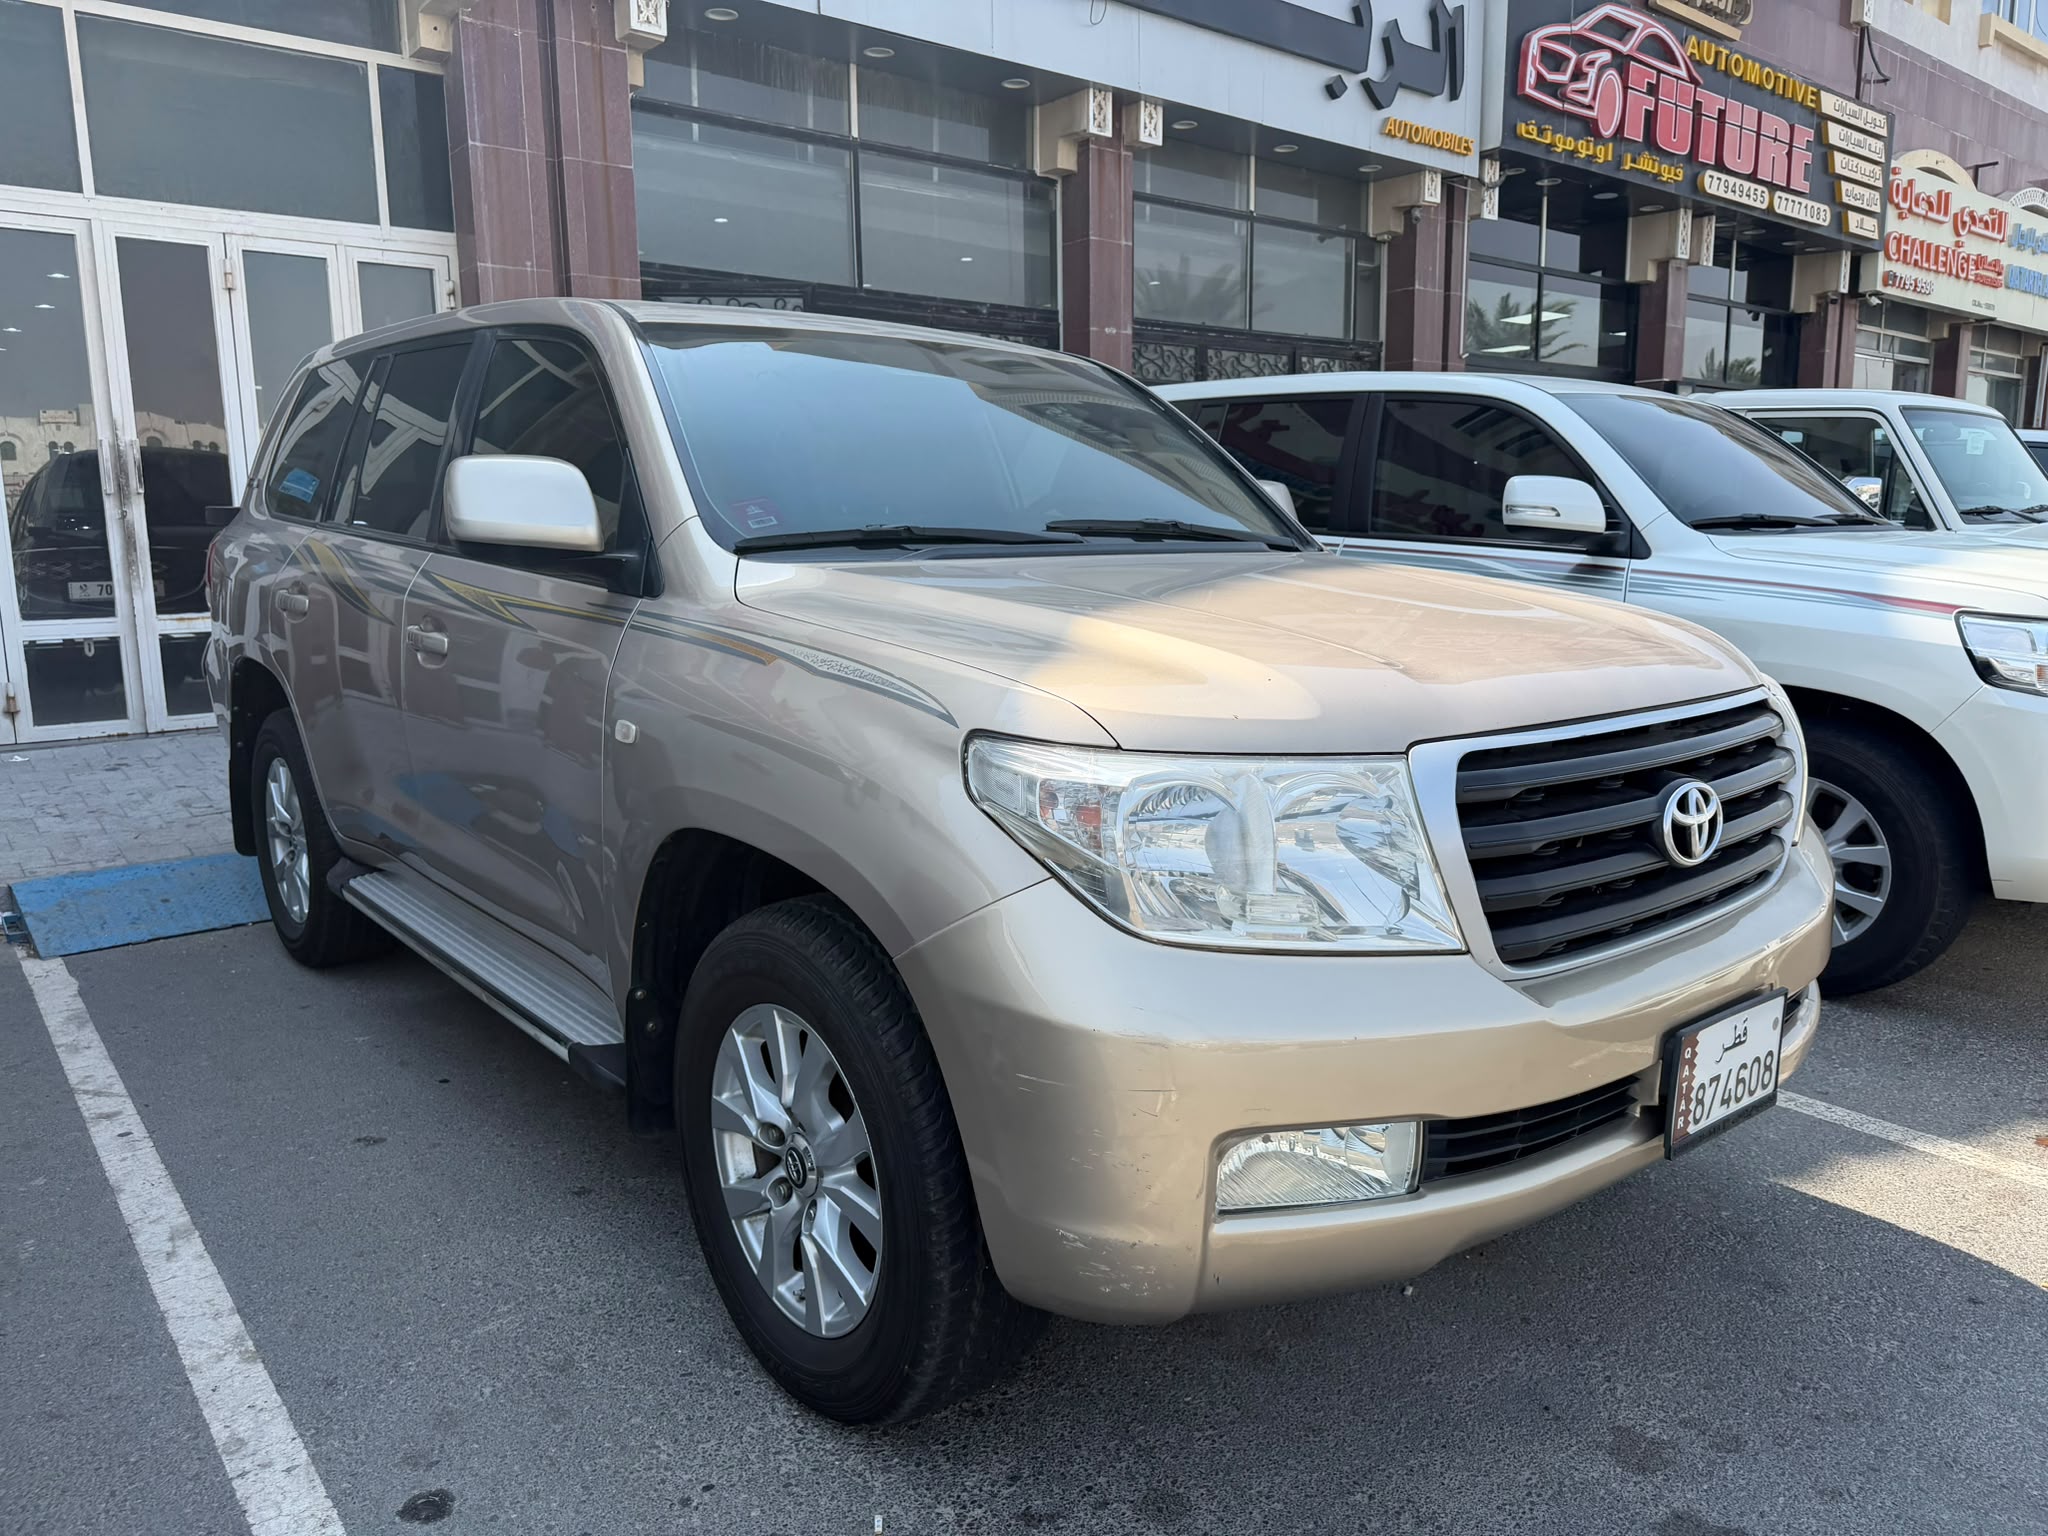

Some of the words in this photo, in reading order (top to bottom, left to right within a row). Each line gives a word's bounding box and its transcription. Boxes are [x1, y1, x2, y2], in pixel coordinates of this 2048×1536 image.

[1686, 35, 1818, 108] AUTOMOTIVE
[1622, 60, 1815, 194] FUTURE
[1834, 98, 1863, 121] السيارات
[1382, 116, 1475, 157] AUTOMOBILES
[1839, 129, 1867, 152] السيارات
[1620, 151, 1685, 183] فيوتشر
[1708, 174, 1766, 205] 77949455
[1777, 195, 1828, 223] 77771083
[1884, 231, 1977, 281] CHALLENGE
[1894, 272, 1915, 291] 7795
[1715, 1017, 1749, 1064] قطر
[1677, 1047, 1692, 1130] QATAR
[1692, 1050, 1775, 1126] 874608
